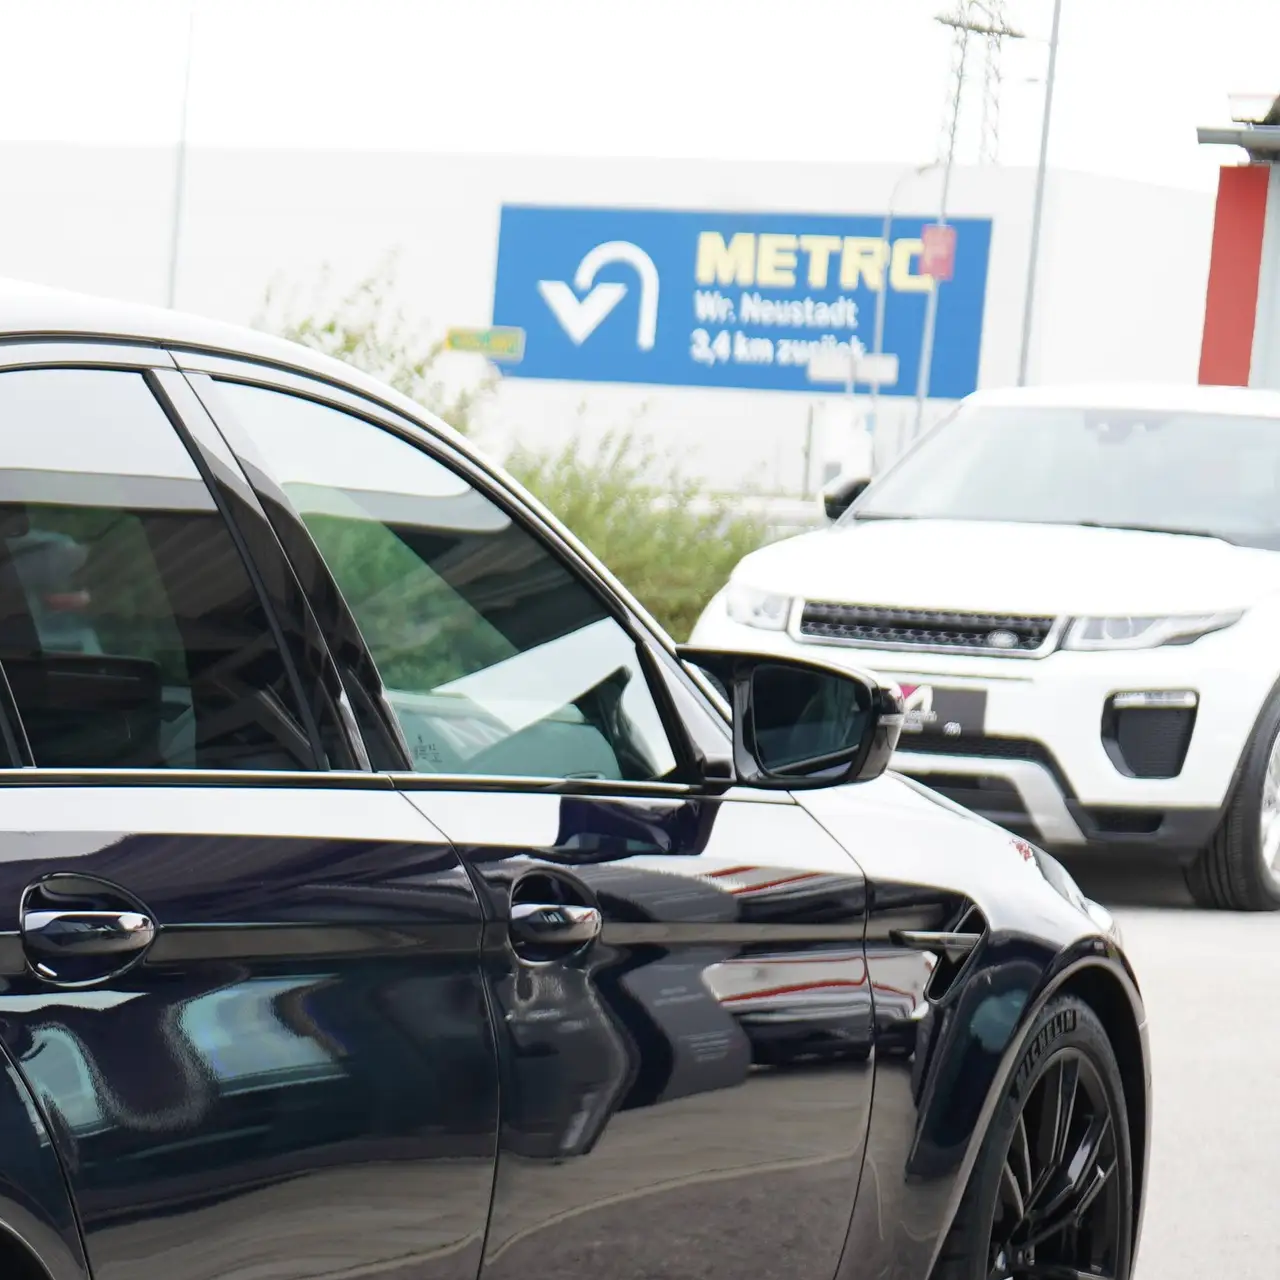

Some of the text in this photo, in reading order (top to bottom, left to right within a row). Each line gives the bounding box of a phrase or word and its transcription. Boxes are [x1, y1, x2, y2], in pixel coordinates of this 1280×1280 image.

[694, 290, 859, 329] Wr. Neustadt
[690, 328, 731, 366] 3,4
[733, 331, 774, 364] km
